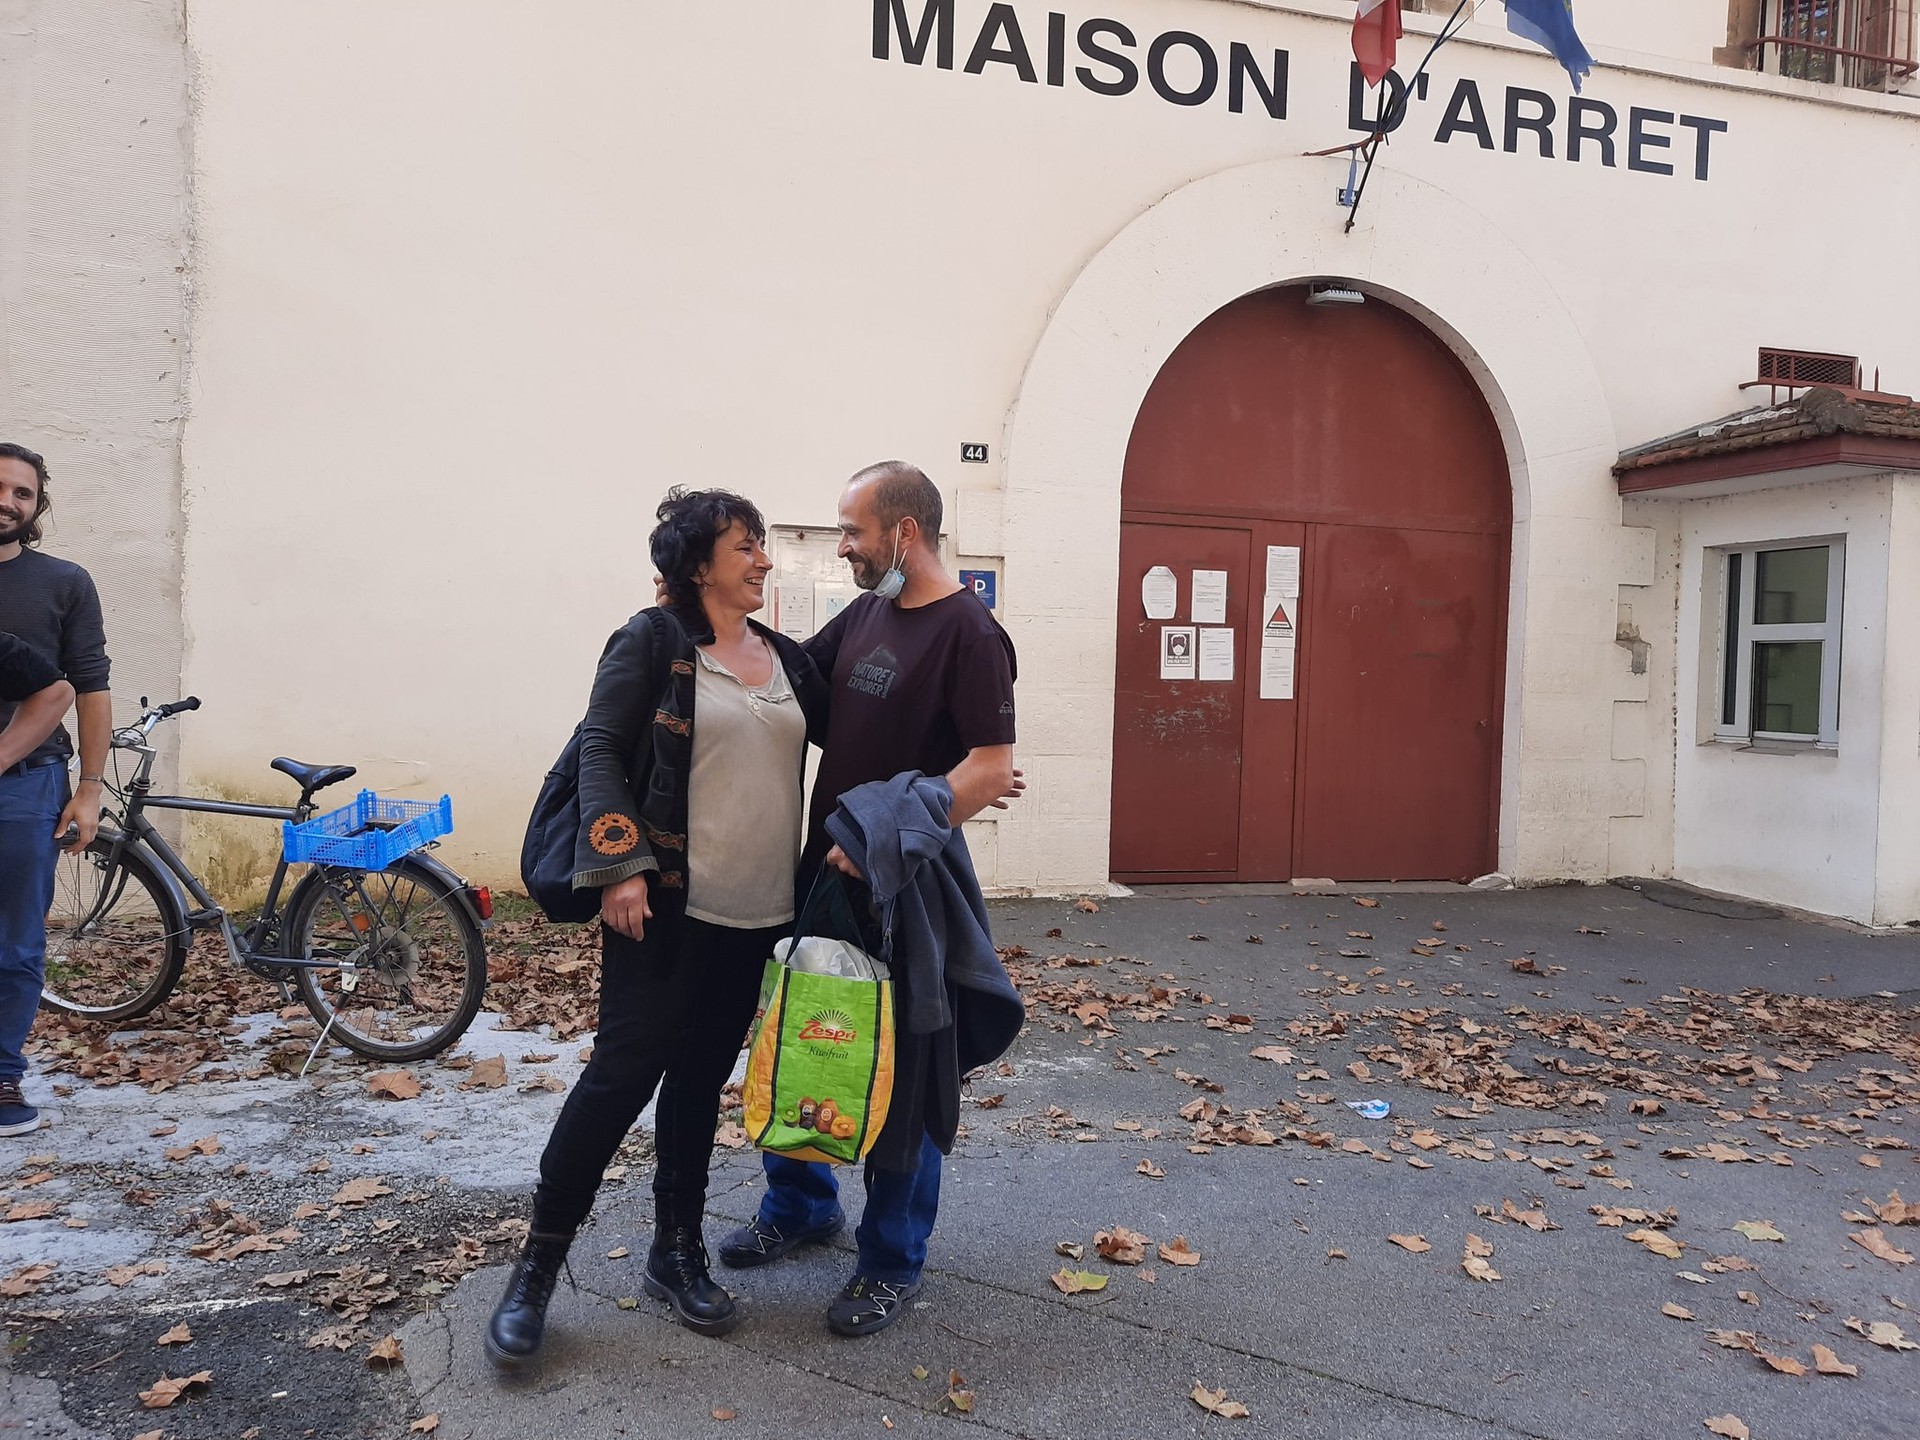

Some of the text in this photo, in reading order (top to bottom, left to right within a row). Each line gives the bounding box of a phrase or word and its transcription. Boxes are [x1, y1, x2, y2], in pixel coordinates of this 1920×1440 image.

[872, 0, 1728, 181] MAISON D'ARRET
[966, 446, 983, 460] 44
[851, 660, 891, 683] NATURE
[846, 675, 884, 697] EXPLORER
[799, 1020, 857, 1045] Zespri
[808, 1046, 849, 1060] Kiwifruit
